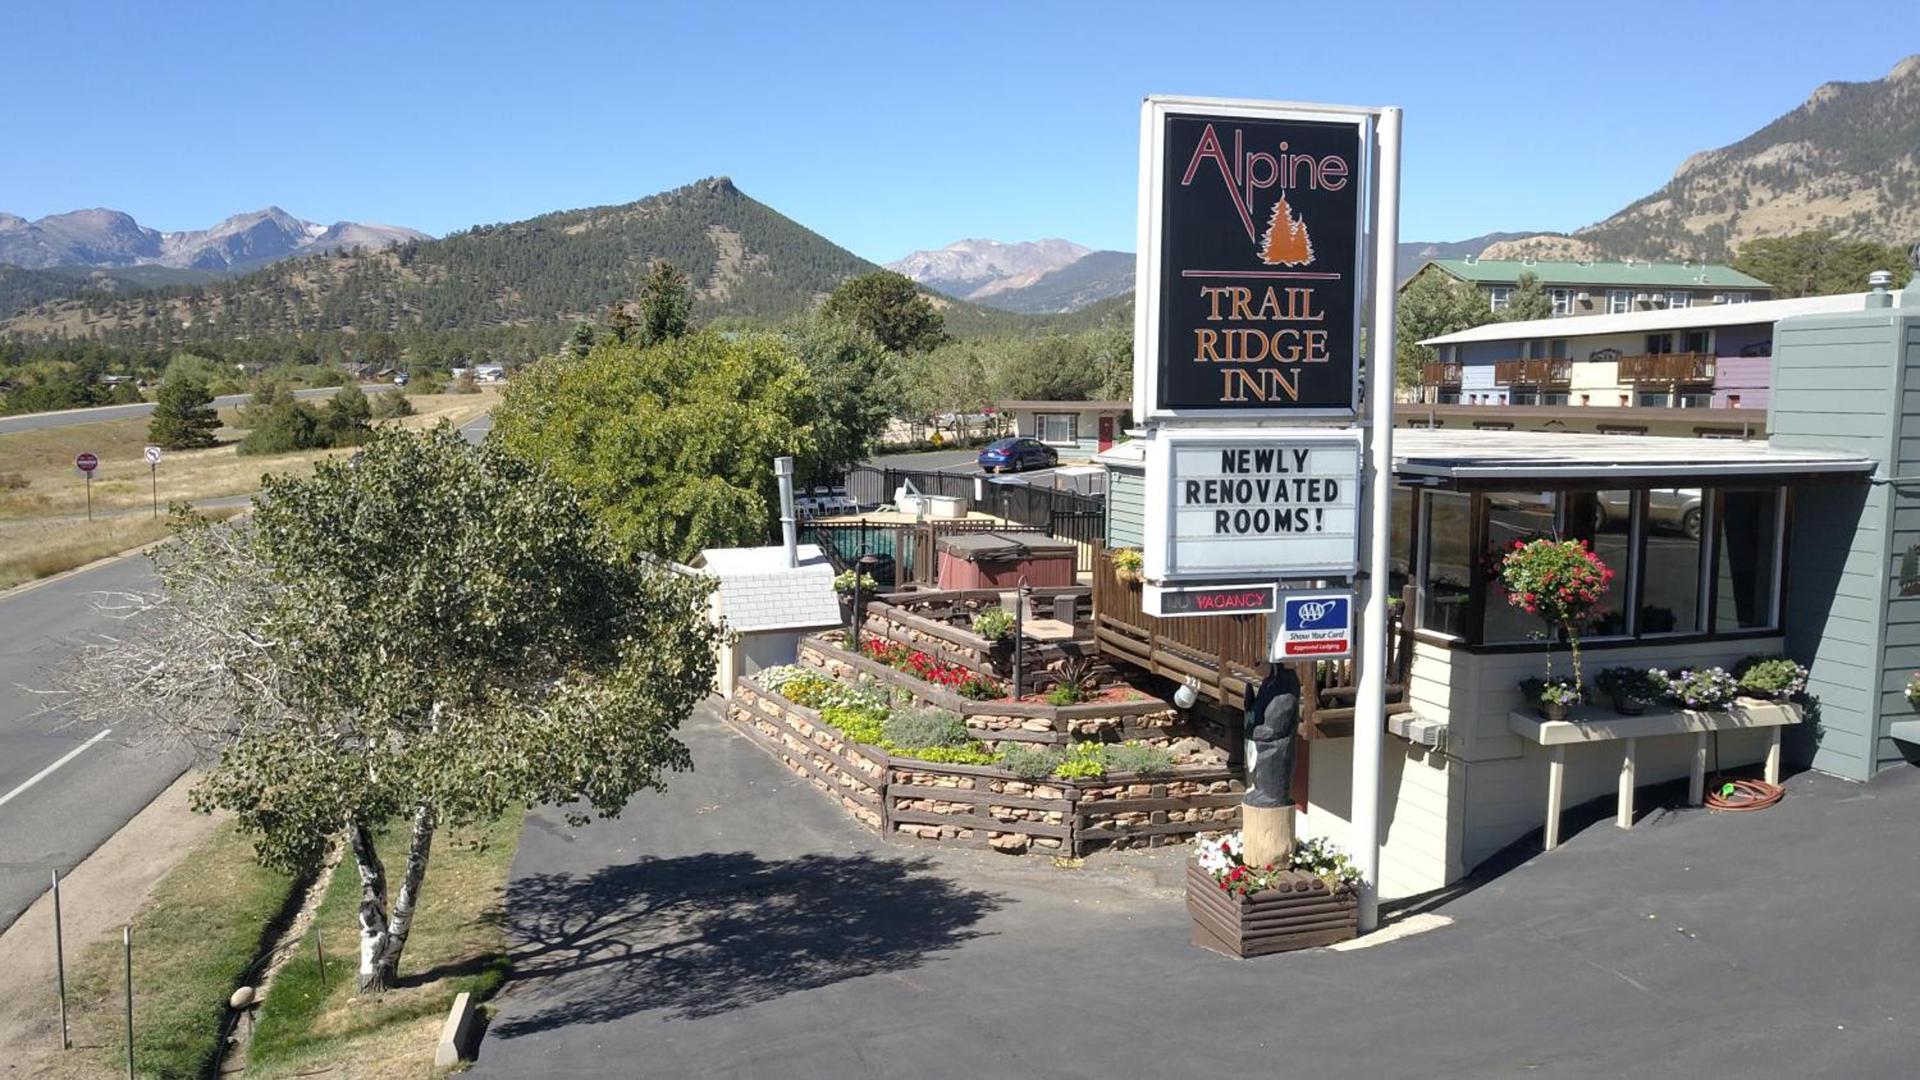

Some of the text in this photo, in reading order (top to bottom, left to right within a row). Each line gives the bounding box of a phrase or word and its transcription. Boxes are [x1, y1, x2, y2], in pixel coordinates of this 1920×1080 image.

[1181, 123, 1349, 244] Alpine
[1200, 286, 1325, 321] TRAIL
[1193, 328, 1330, 363] RIDGE
[1219, 368, 1301, 402] INN
[1221, 449, 1309, 474] NEWLY
[1185, 478, 1339, 504] RENOVATED
[1215, 508, 1323, 534] ROOMS!
[1195, 592, 1267, 610] VACANCY
[1300, 603, 1324, 620] AAA
[1290, 630, 1344, 640] Show Your Card
